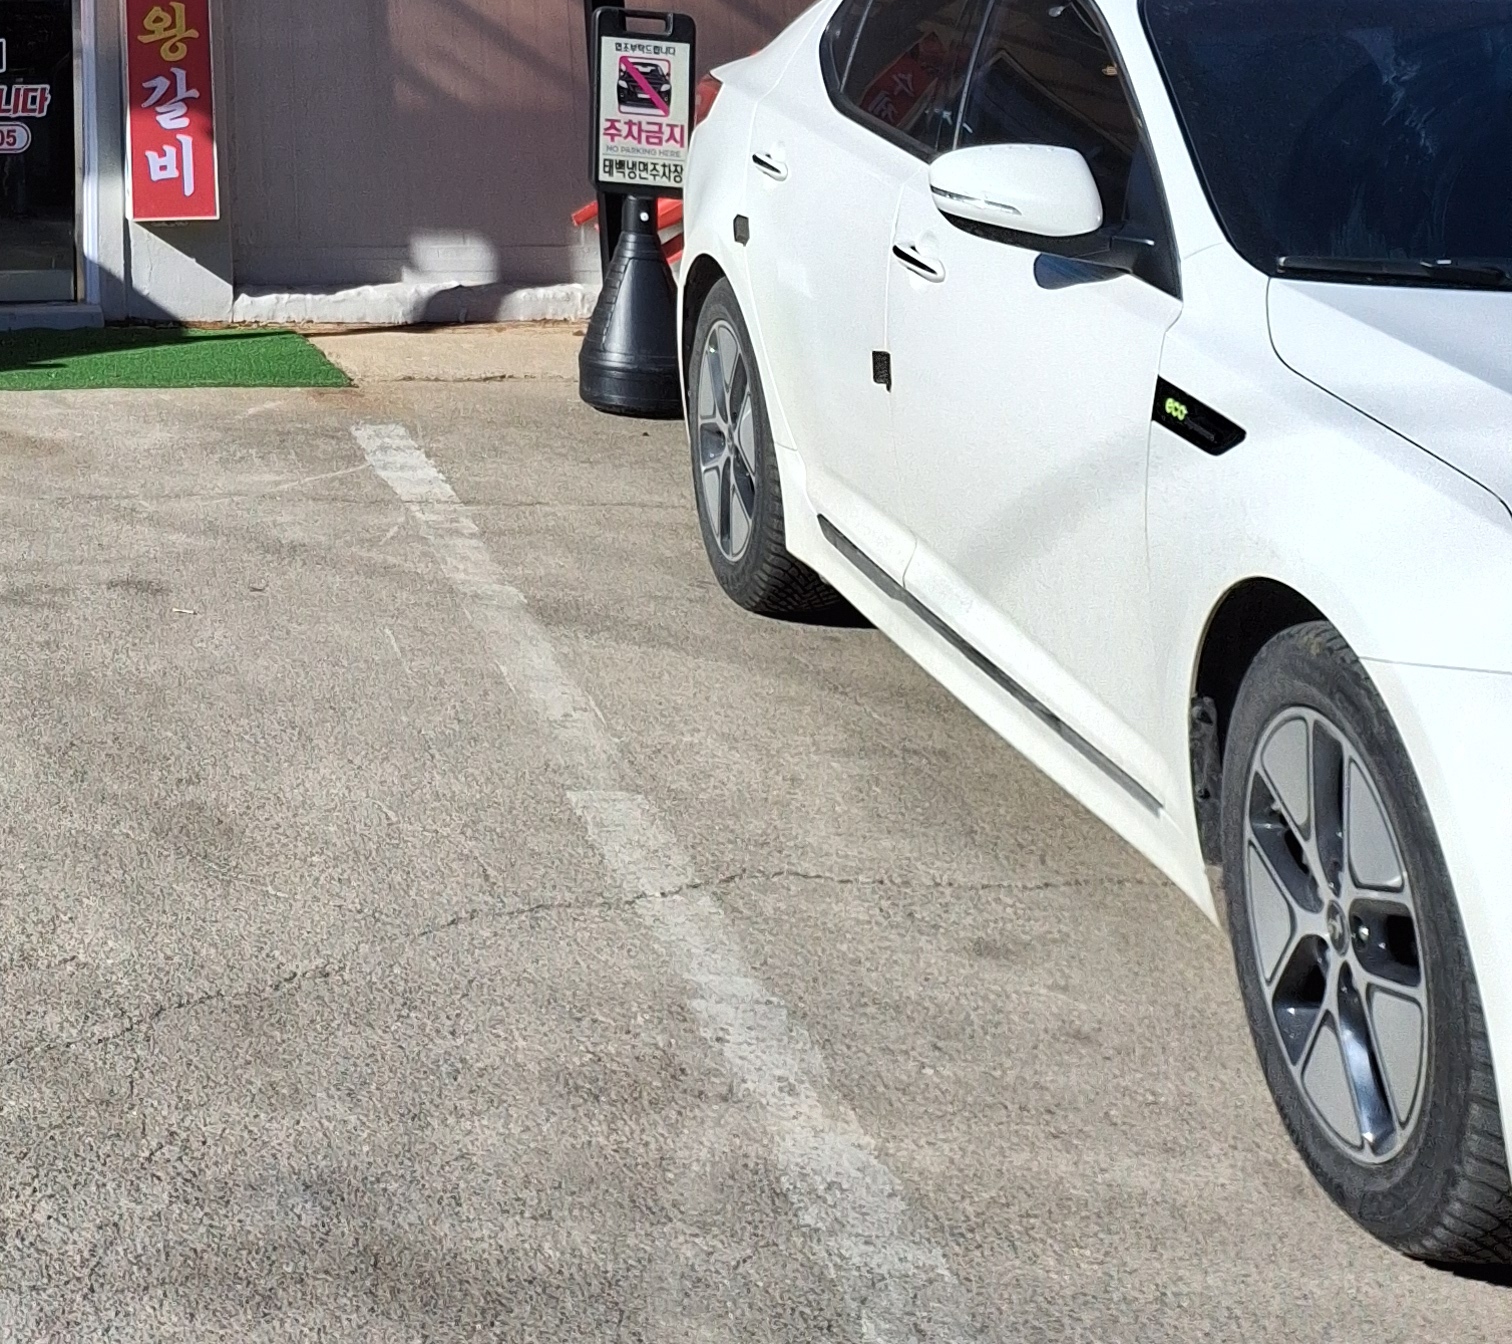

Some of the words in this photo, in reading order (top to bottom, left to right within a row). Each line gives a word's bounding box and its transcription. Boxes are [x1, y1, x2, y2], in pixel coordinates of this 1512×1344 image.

[603, 118, 685, 148] 주차금지
[621, 146, 657, 156] PARKING
[603, 158, 683, 184] 태백냉면주차장
